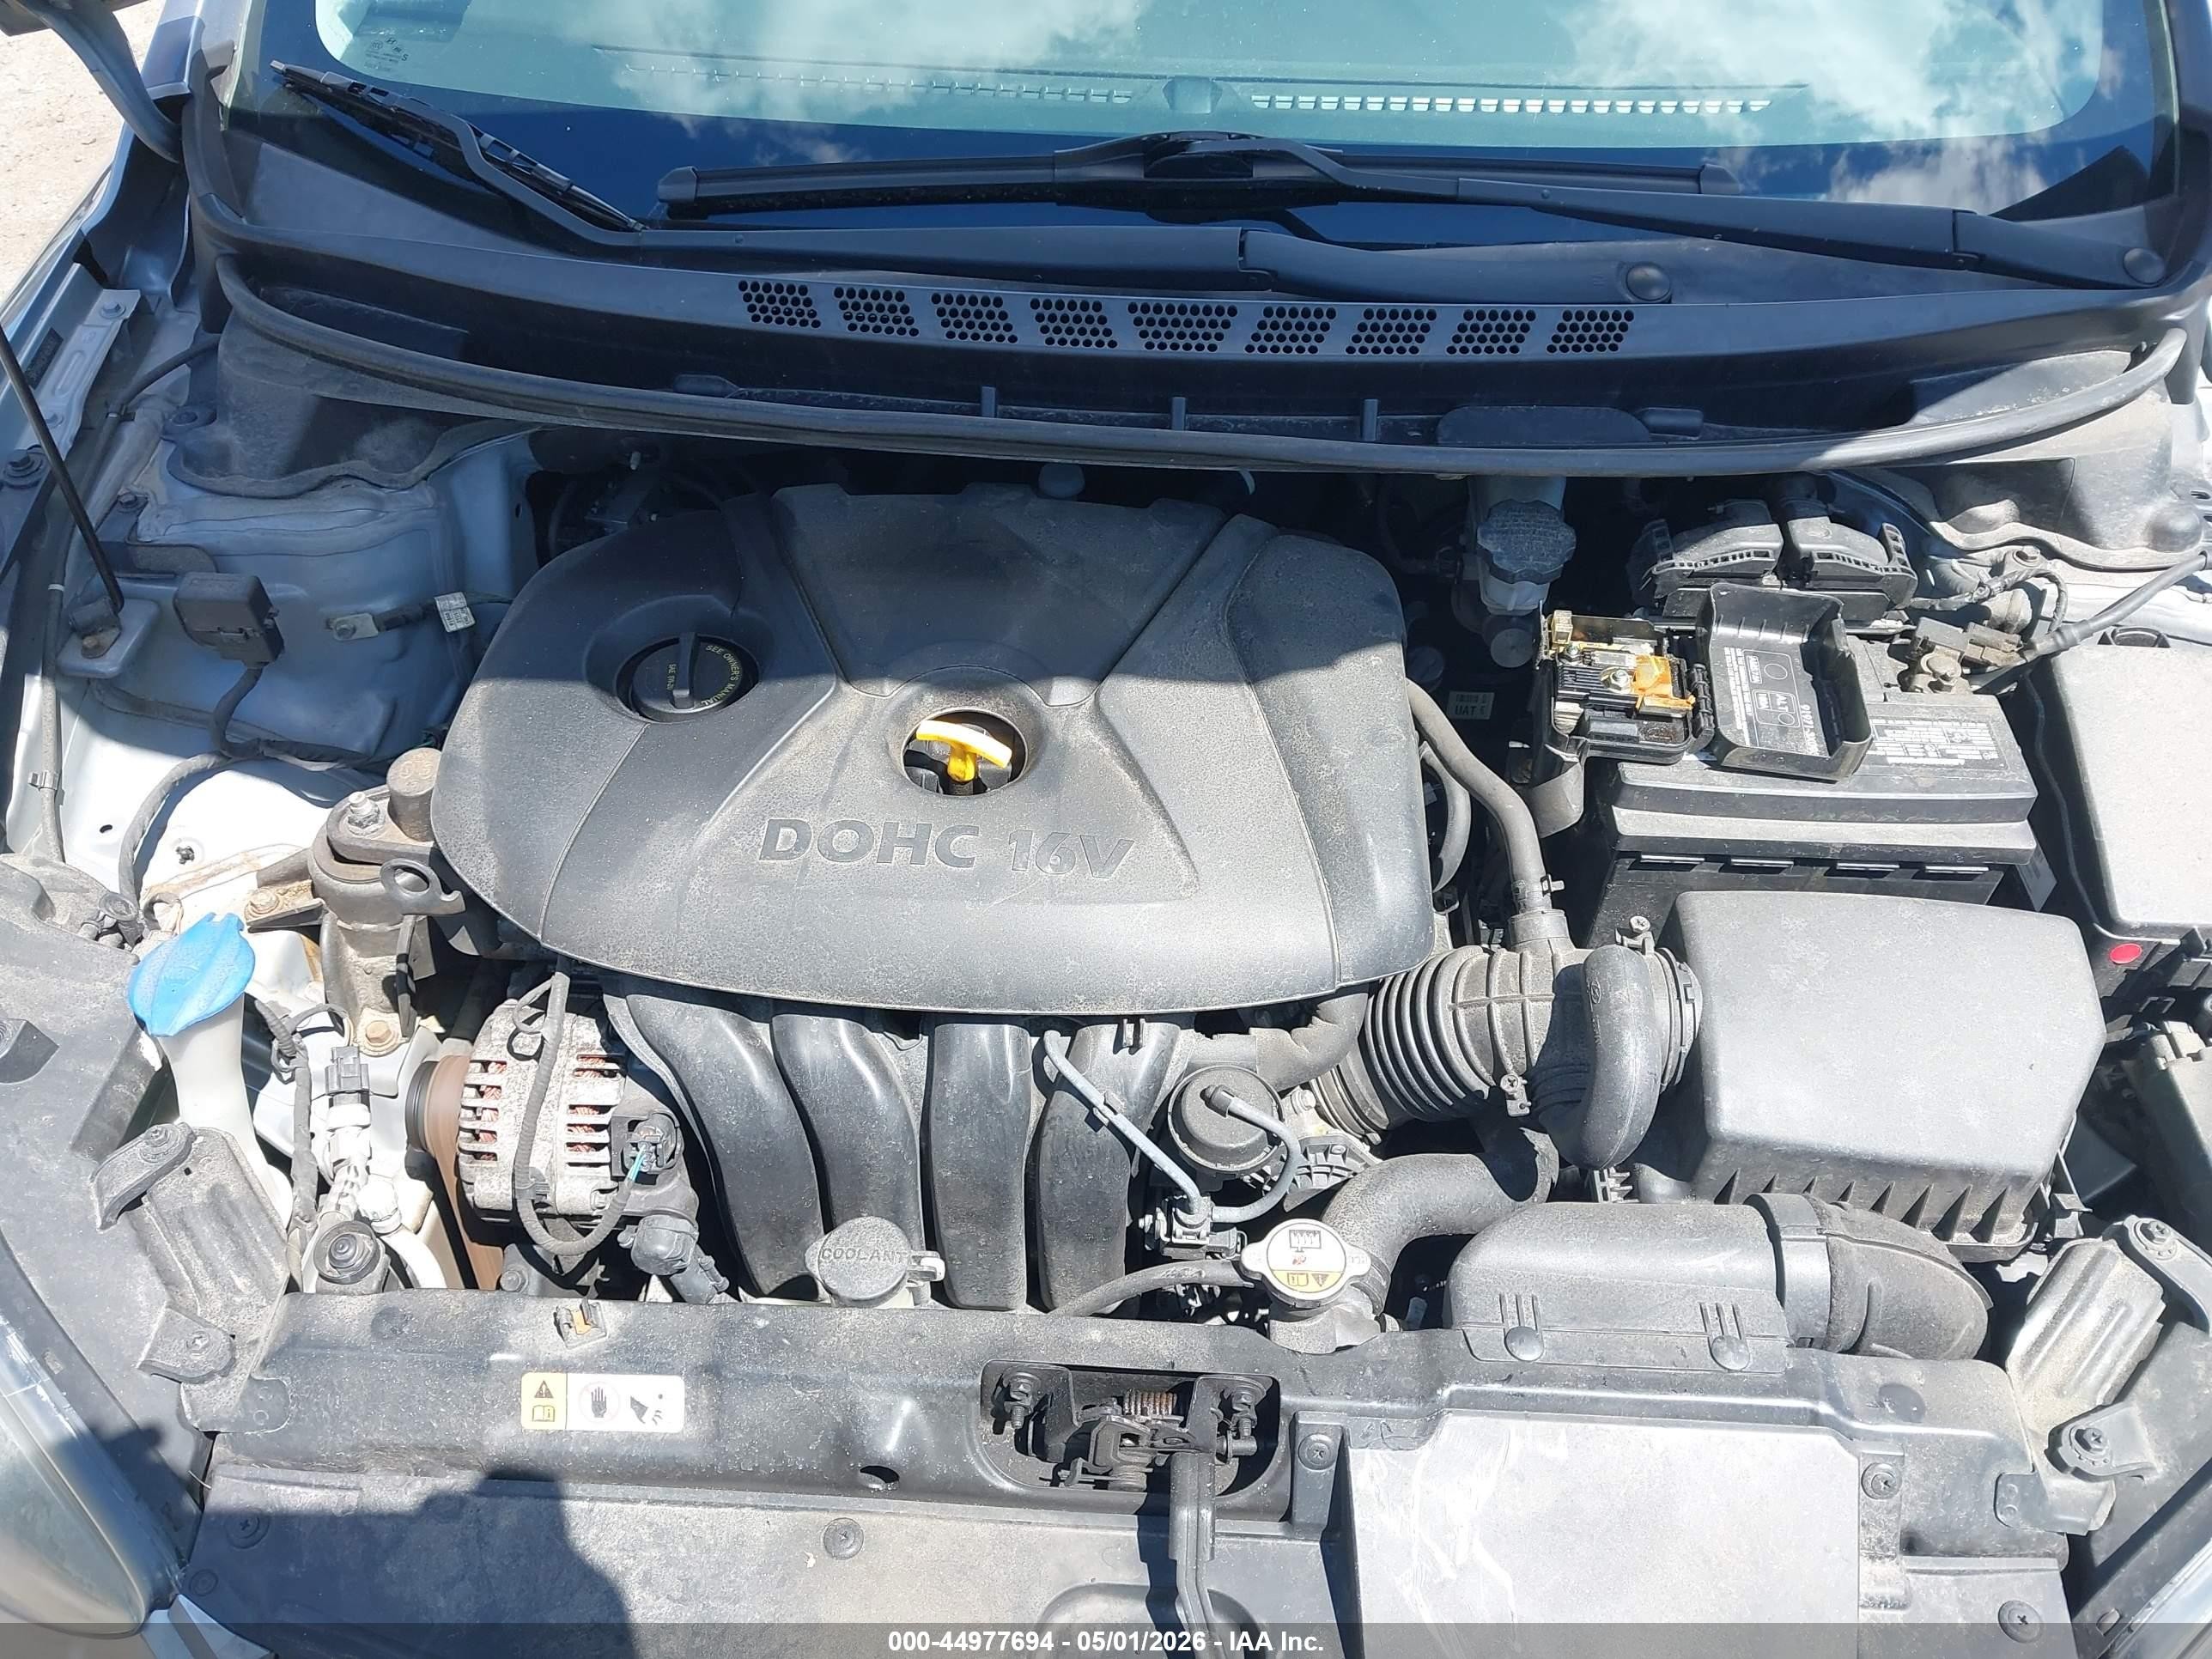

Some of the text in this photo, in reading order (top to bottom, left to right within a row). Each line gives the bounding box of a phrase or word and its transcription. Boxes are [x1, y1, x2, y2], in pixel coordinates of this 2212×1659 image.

[700, 645, 739, 707] SEE OWNER'S MANUAL
[1775, 694, 1789, 713] ALT
[759, 817, 1135, 879] DOHC 16V
[821, 1248, 907, 1264] COOLANT
